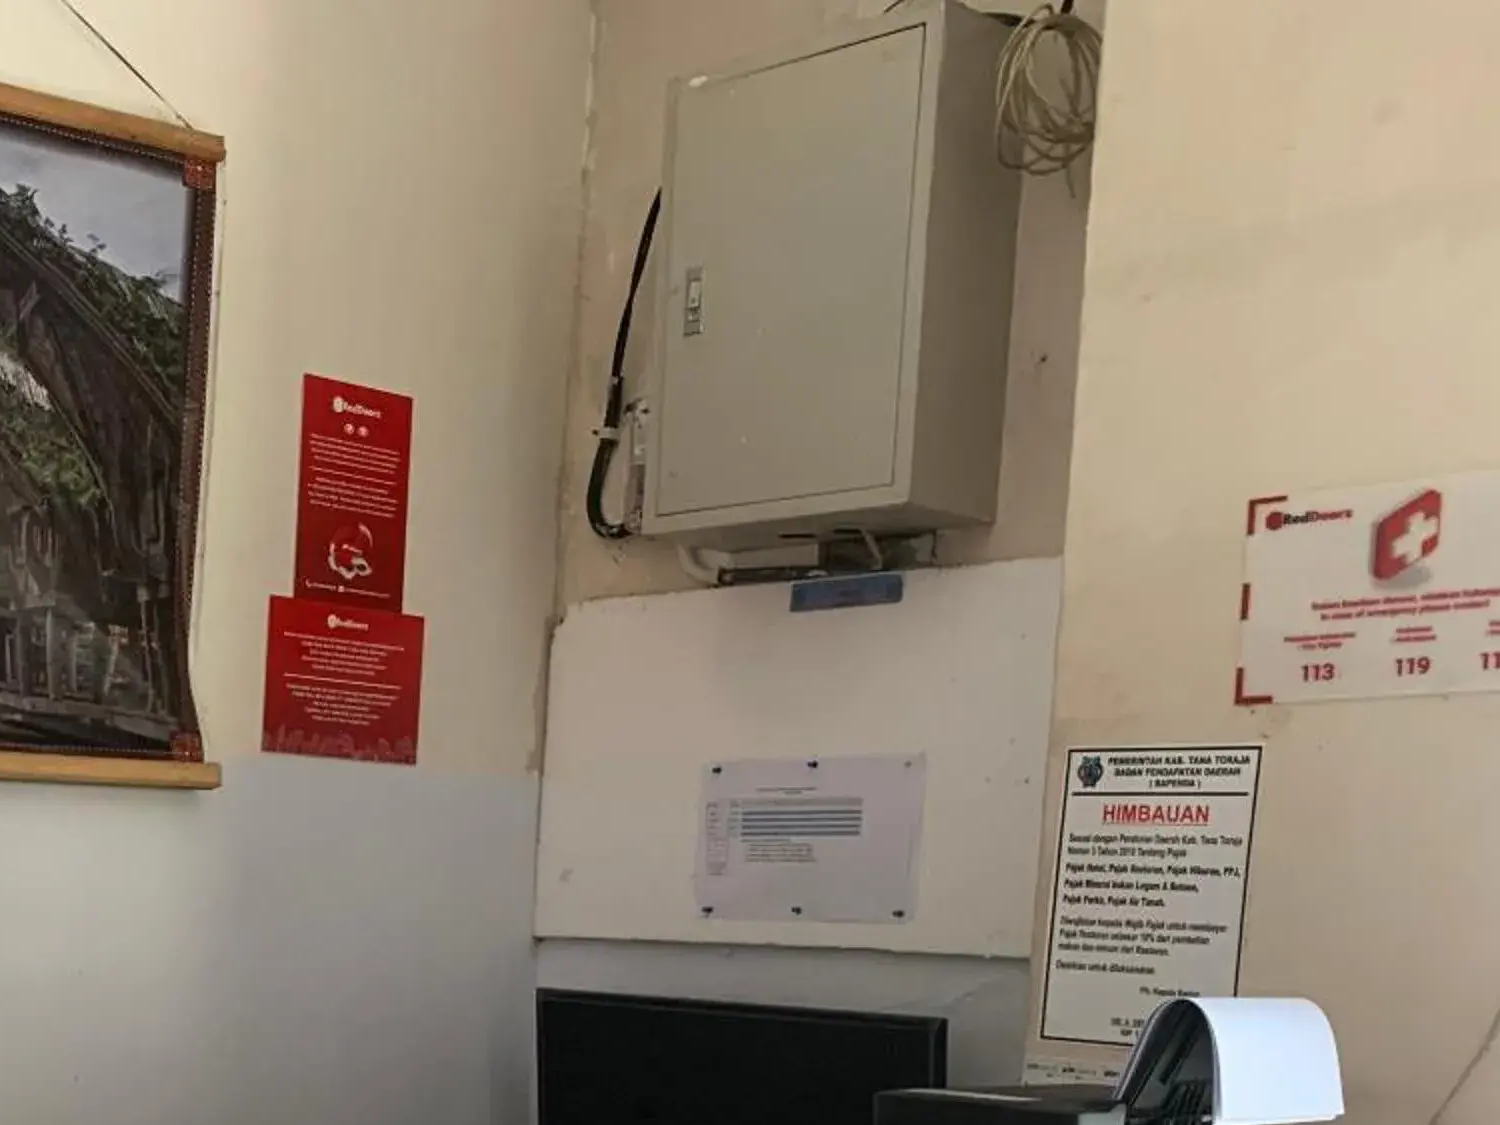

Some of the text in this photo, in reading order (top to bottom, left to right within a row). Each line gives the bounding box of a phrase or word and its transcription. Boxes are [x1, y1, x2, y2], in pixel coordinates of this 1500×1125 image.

[1395, 656, 1431, 677] 119
[1480, 651, 1500, 671] 11
[1301, 663, 1335, 683] 113
[1108, 756, 1162, 766] PEMERINTAH
[1189, 755, 1212, 765] TANA
[1214, 755, 1250, 764] TORAJA
[1114, 767, 1241, 777] BADAN PENDAPATAN DAERAH
[1102, 803, 1210, 824] HIMBAUAN
